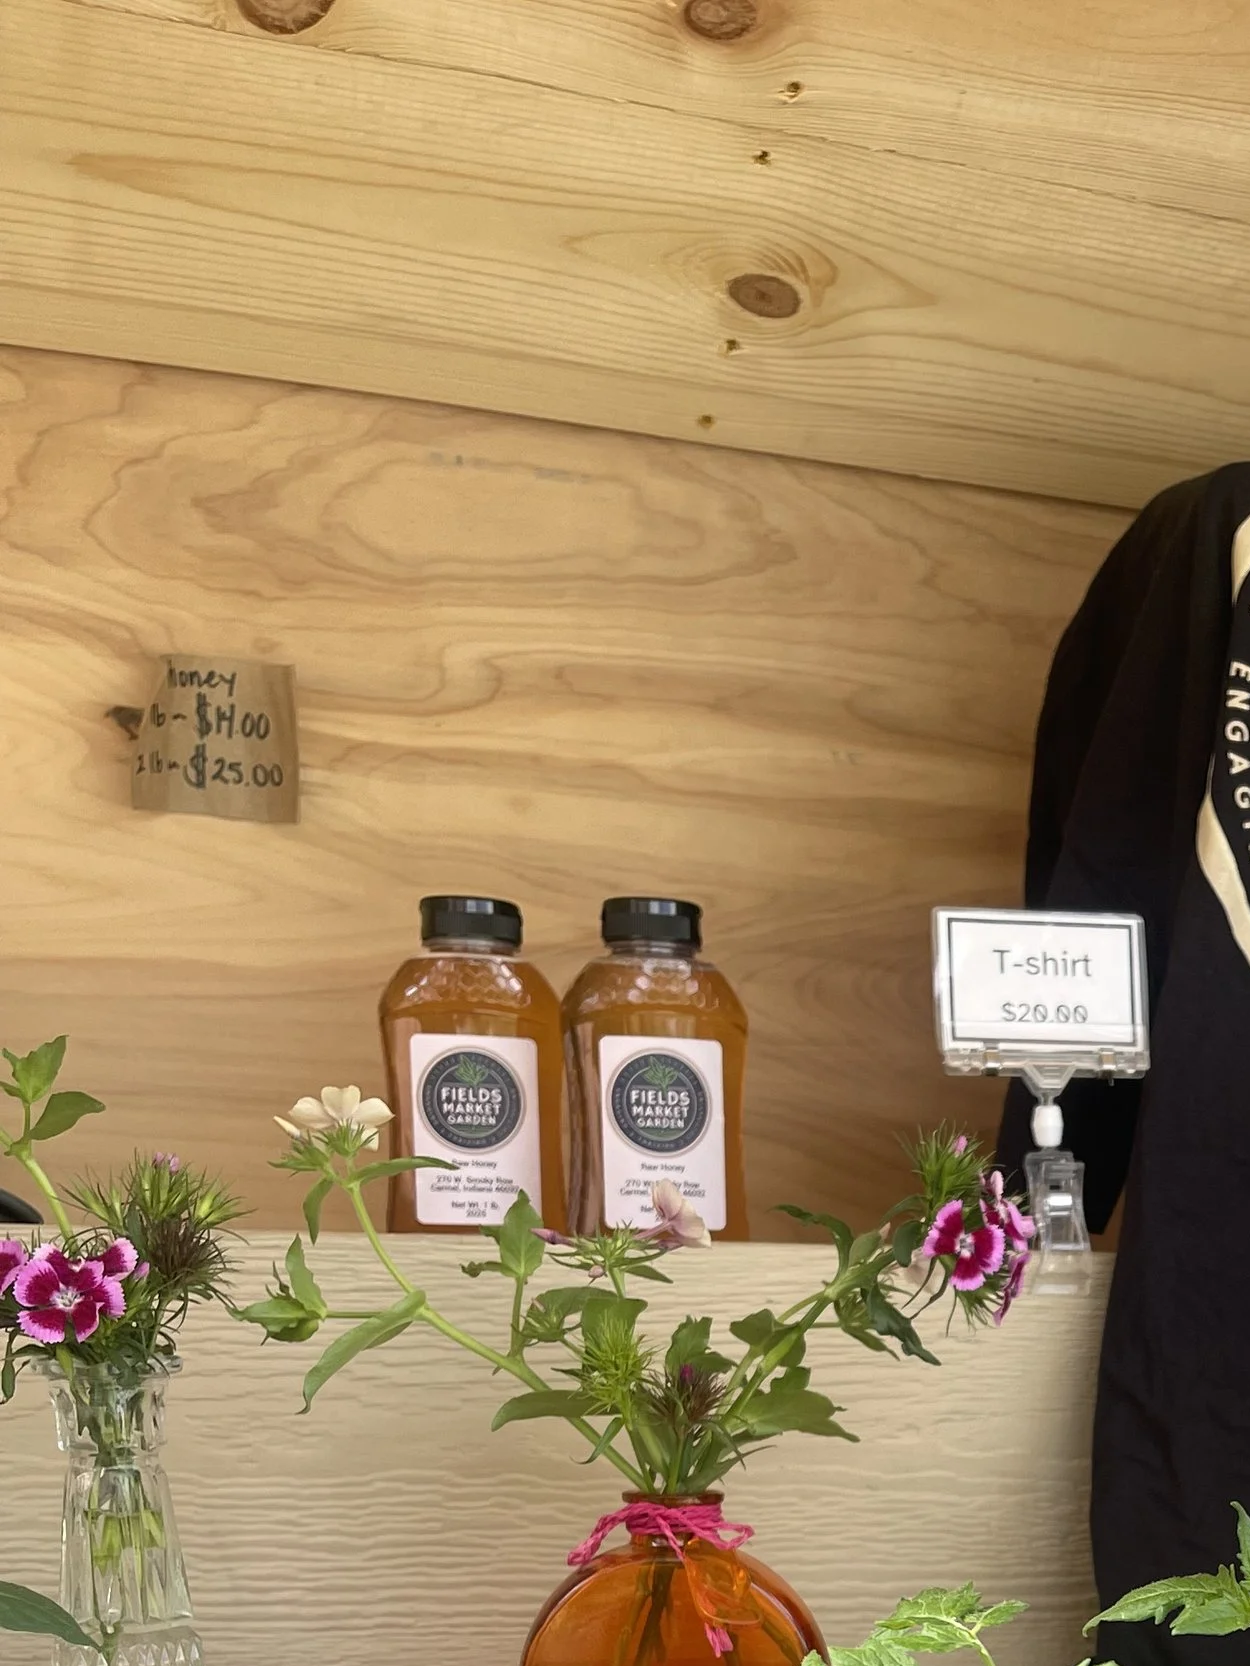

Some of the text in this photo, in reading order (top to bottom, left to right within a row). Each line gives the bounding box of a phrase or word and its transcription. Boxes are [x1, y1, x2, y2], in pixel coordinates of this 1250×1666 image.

[184, 743, 284, 789] $25.00
[992, 949, 1092, 977] T-shirt
[1002, 1002, 1088, 1023] $20.00
[441, 1086, 502, 1104] FIELDS
[630, 1090, 690, 1106] FIELDS
[443, 1102, 501, 1116] MARKET
[632, 1105, 689, 1118] MARKET
[447, 1114, 496, 1126] GARDEN
[637, 1117, 685, 1129] GARDEN
